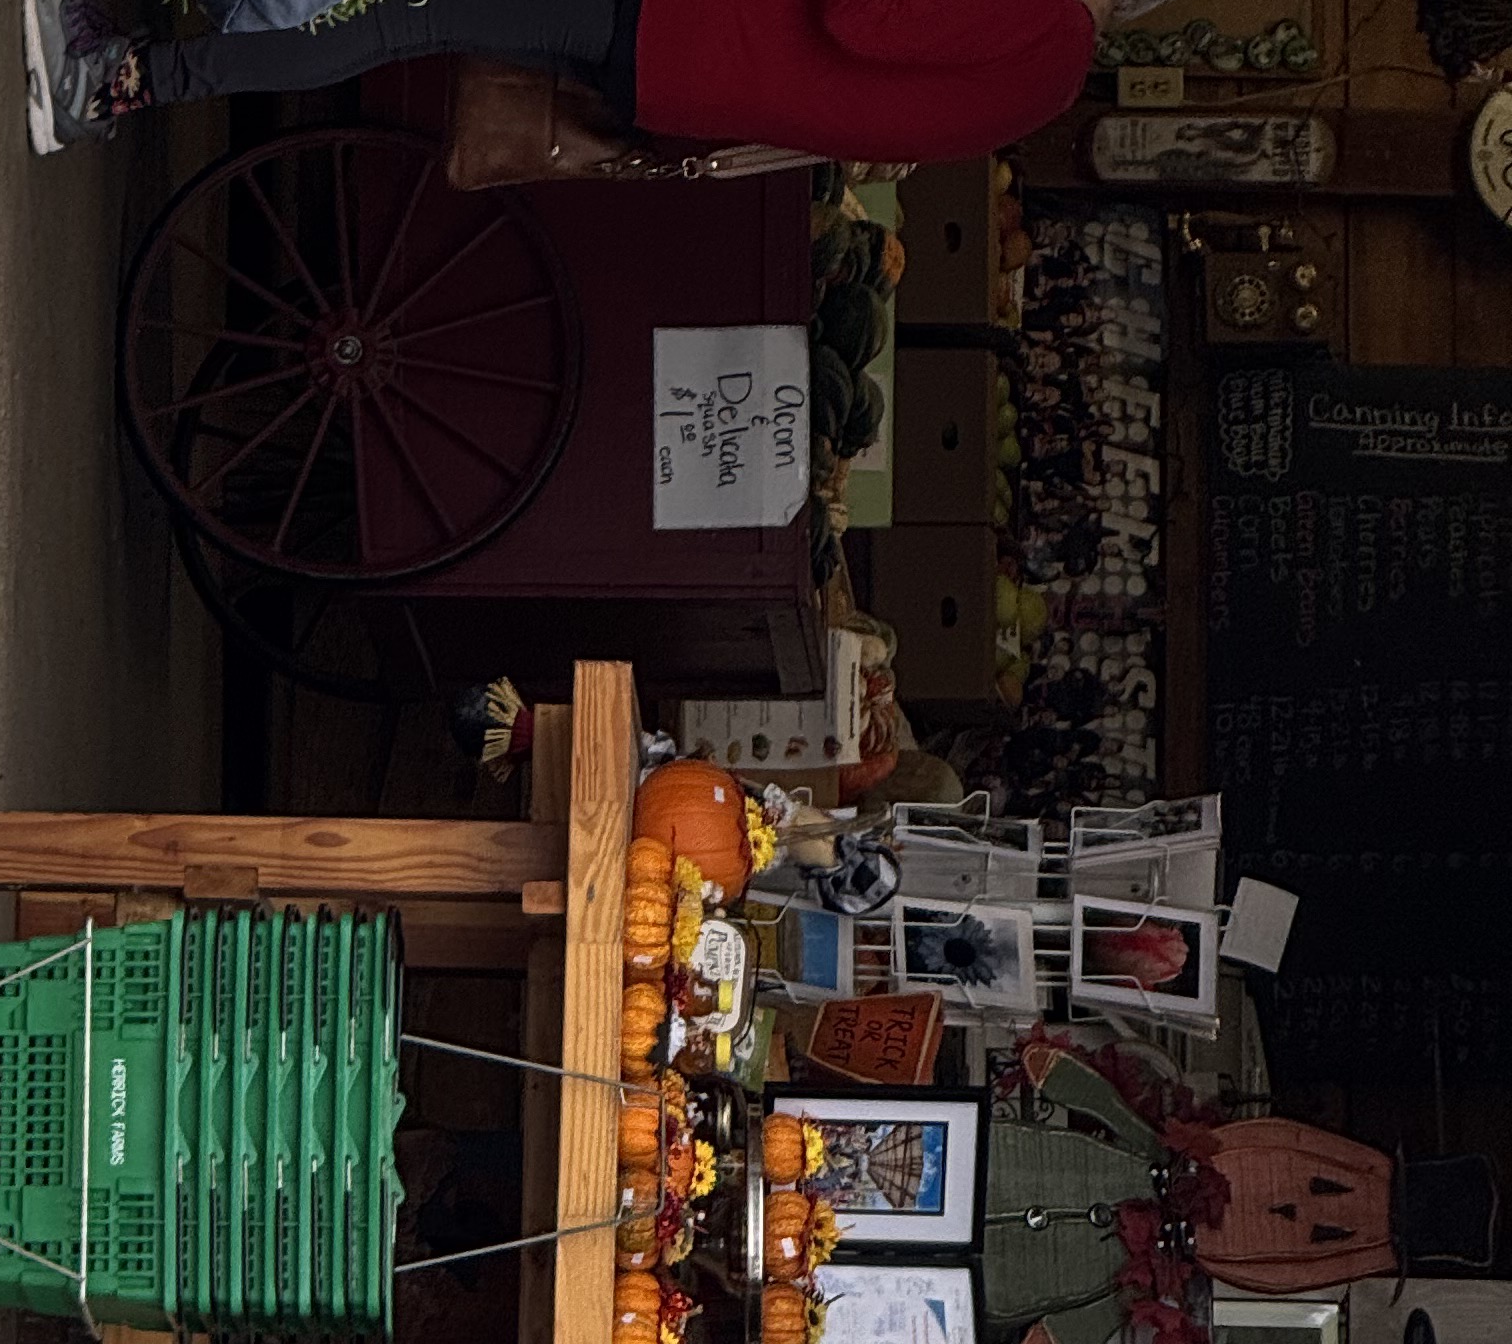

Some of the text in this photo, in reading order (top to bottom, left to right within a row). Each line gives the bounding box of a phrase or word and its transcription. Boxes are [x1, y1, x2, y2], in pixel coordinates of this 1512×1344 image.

[716, 371, 752, 489] Delicata
[1101, 238, 1162, 568] CHEER
[1308, 393, 1440, 438] Canning
[659, 446, 675, 485] each
[1237, 494, 1266, 571] Corn
[827, 1005, 860, 1065] TREAT
[857, 1020, 884, 1043] OR
[874, 1005, 916, 1071] TRICK
[109, 1058, 127, 1166] HERRICK FARMS
